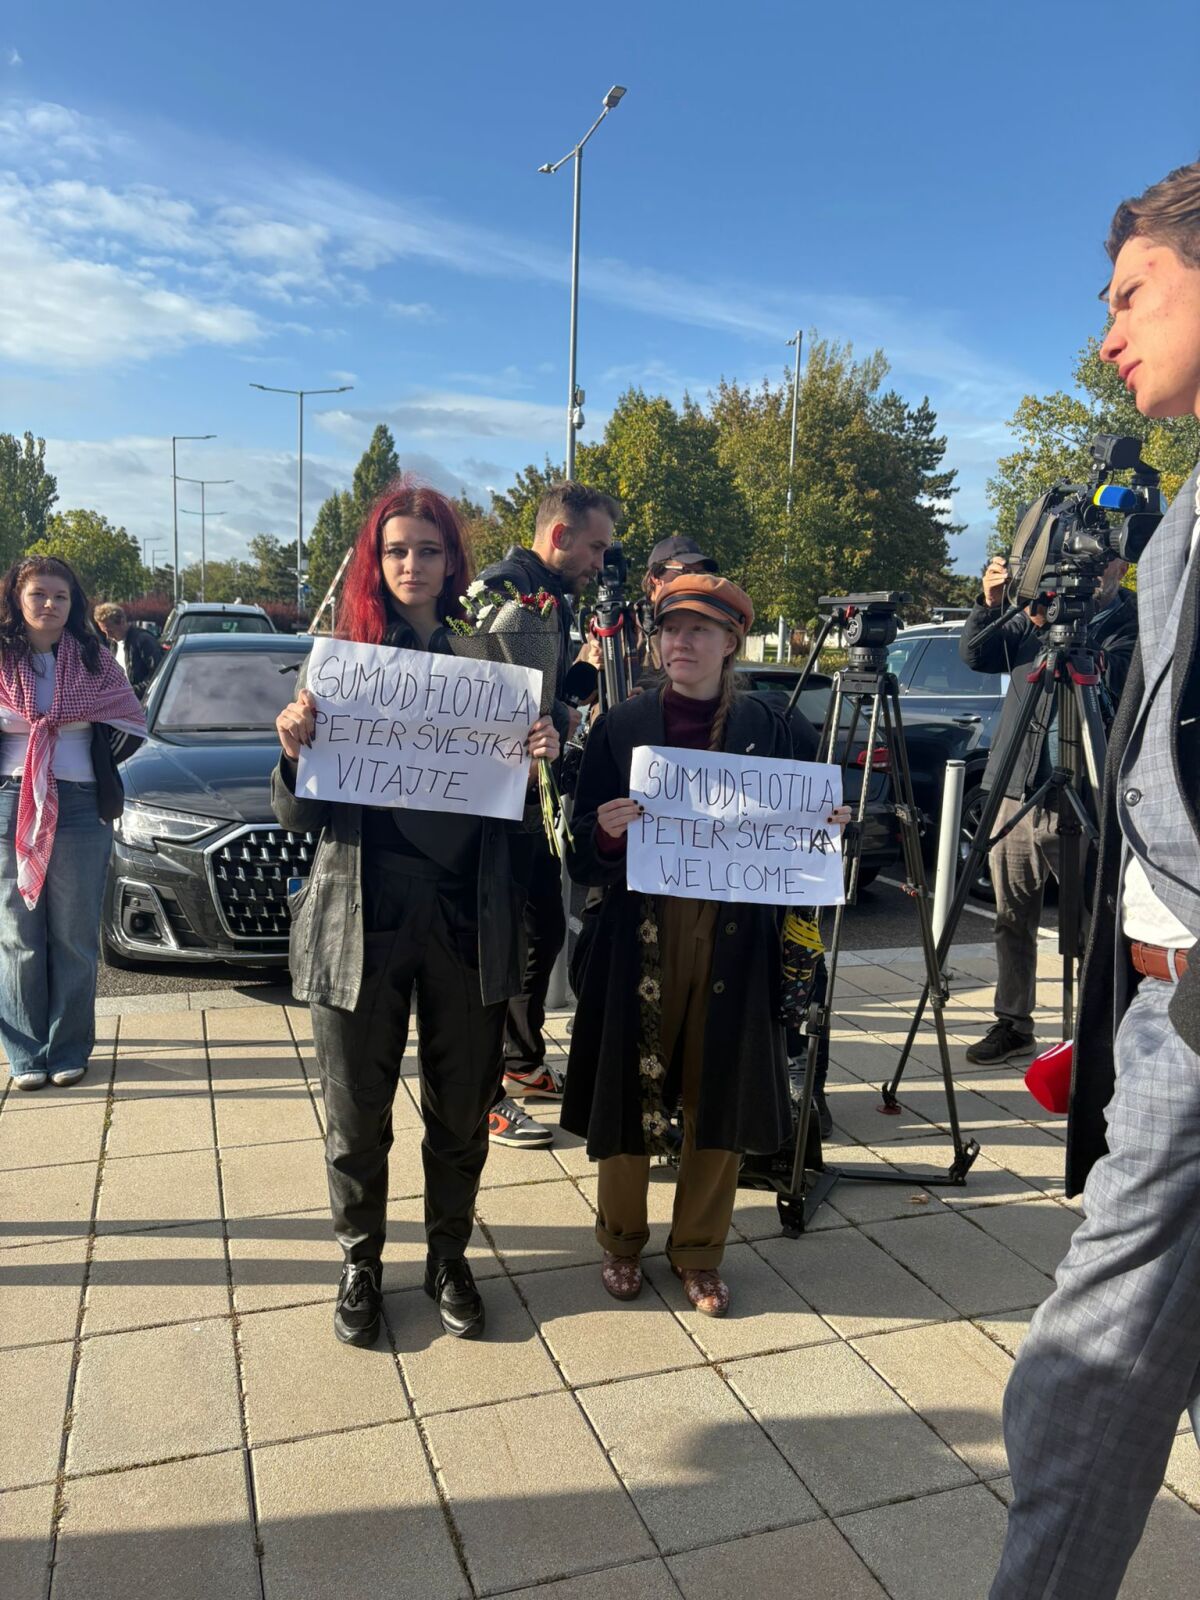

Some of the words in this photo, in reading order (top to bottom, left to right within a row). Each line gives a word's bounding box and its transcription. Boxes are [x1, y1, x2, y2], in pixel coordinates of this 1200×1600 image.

[315, 655, 418, 711] SUMUD
[424, 674, 531, 726] FLOTILA
[313, 710, 407, 751] PETER
[412, 717, 526, 764] ŠVESTKA
[337, 753, 469, 802] VITAJTE
[643, 760, 736, 810] SUMUD
[740, 769, 835, 813] FLOTILA
[641, 812, 730, 851] PETER
[735, 811, 837, 856] ŠVESTKA
[659, 855, 805, 895] WELCOME
